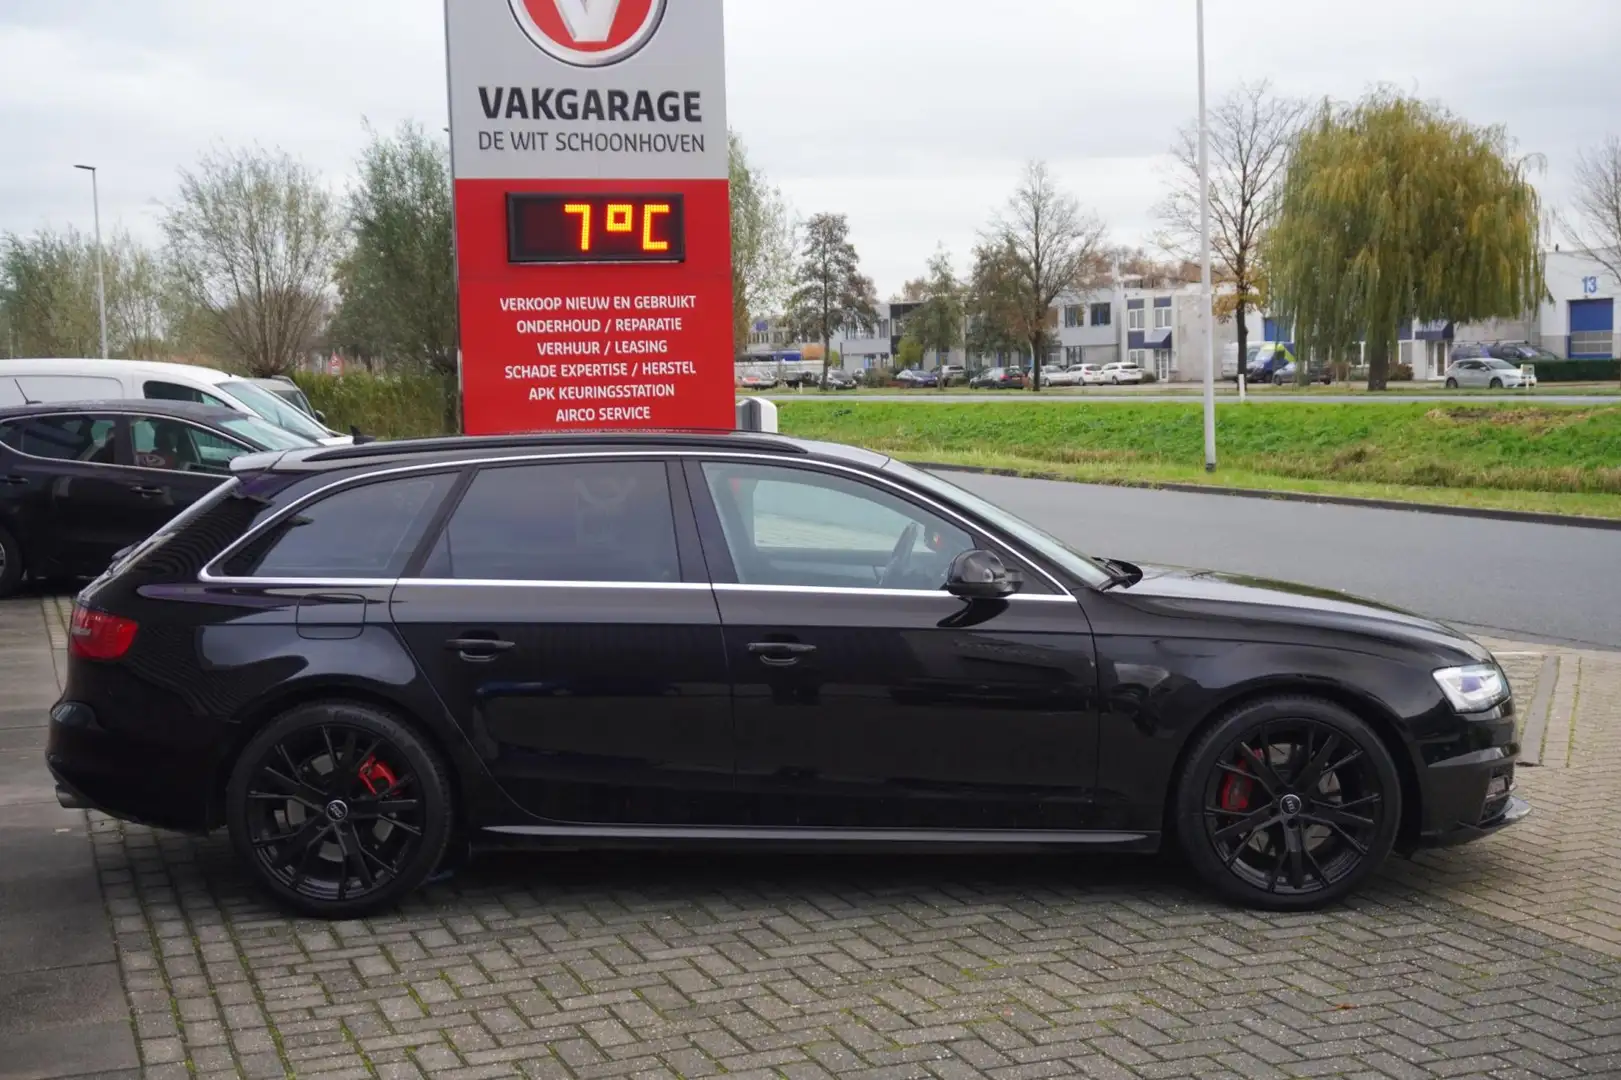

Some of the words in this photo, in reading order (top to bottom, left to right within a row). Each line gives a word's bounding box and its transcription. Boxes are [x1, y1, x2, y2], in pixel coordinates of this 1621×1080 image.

[478, 86, 703, 122] VAKGARAGE
[478, 131, 505, 150] DE
[510, 131, 549, 151] WIT
[555, 132, 705, 152] SCHOONHOVEN
[1582, 276, 1597, 293] 13
[500, 298, 562, 311] VERKOOP
[566, 297, 609, 310] NIEUW
[614, 296, 631, 309] EN
[634, 295, 697, 309] GEBRUIKT
[516, 319, 601, 333] ONDERHOUD
[605, 319, 612, 334] /
[615, 317, 682, 331] REPARATIE
[537, 341, 600, 355] VERHUUR
[604, 341, 611, 356] /
[615, 340, 668, 353] LEASING
[505, 364, 557, 379] SCHADE
[561, 363, 628, 377] EXPERTISE
[631, 362, 639, 377] /
[642, 361, 697, 375] HERSTEL
[529, 386, 555, 400] APK
[559, 384, 675, 399] KEURINGSSTATION
[556, 408, 596, 422] AIRCO
[599, 406, 651, 420] SERVICE
